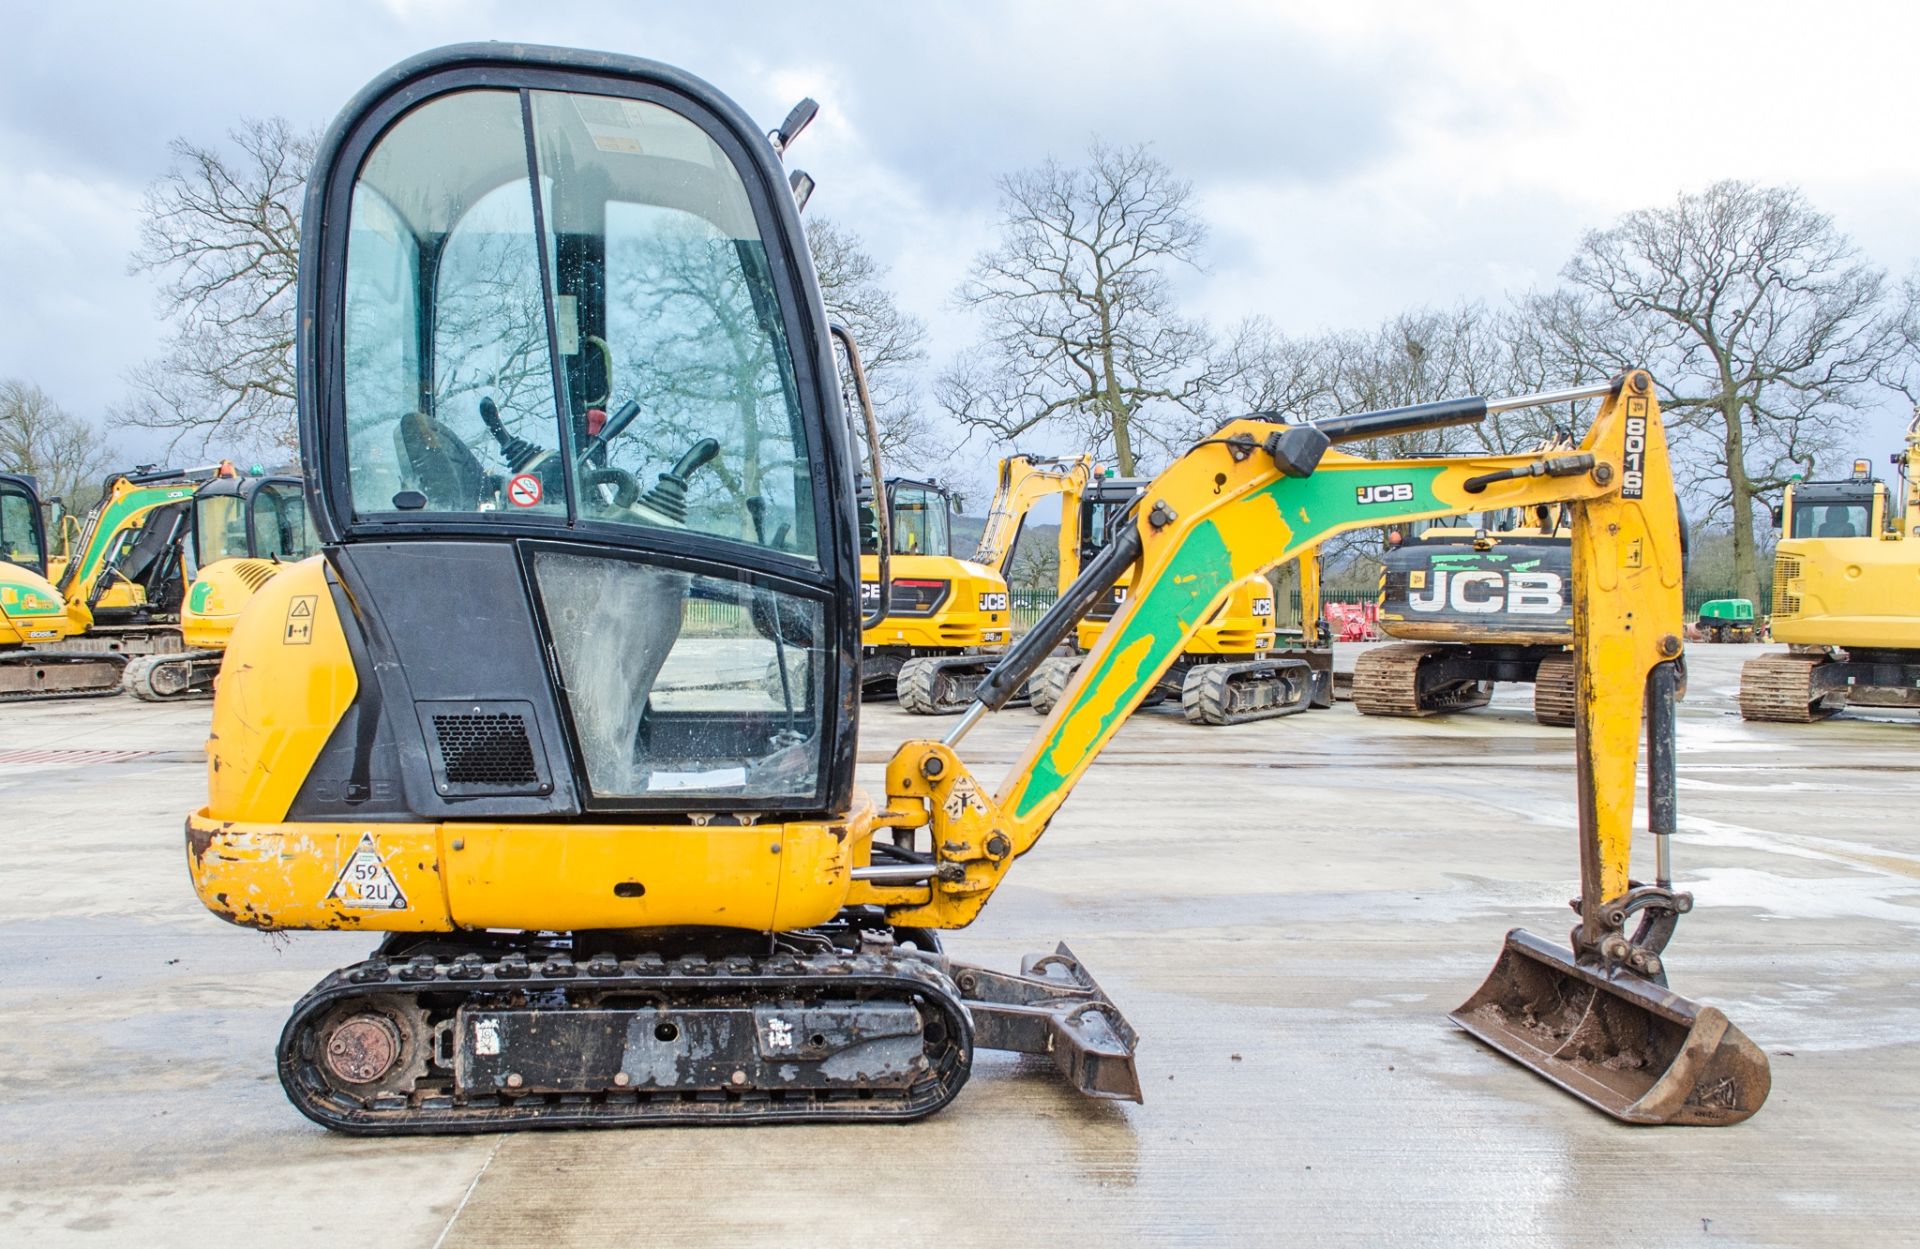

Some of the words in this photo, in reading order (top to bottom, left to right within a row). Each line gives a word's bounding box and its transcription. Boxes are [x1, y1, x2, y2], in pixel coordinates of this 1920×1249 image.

[1623, 418, 1646, 489] 8016
[1357, 484, 1413, 504] JCB
[1409, 570, 1564, 614] JCB
[979, 593, 1006, 610] JCB
[1252, 599, 1271, 615] JCB
[355, 864, 378, 880] 59
